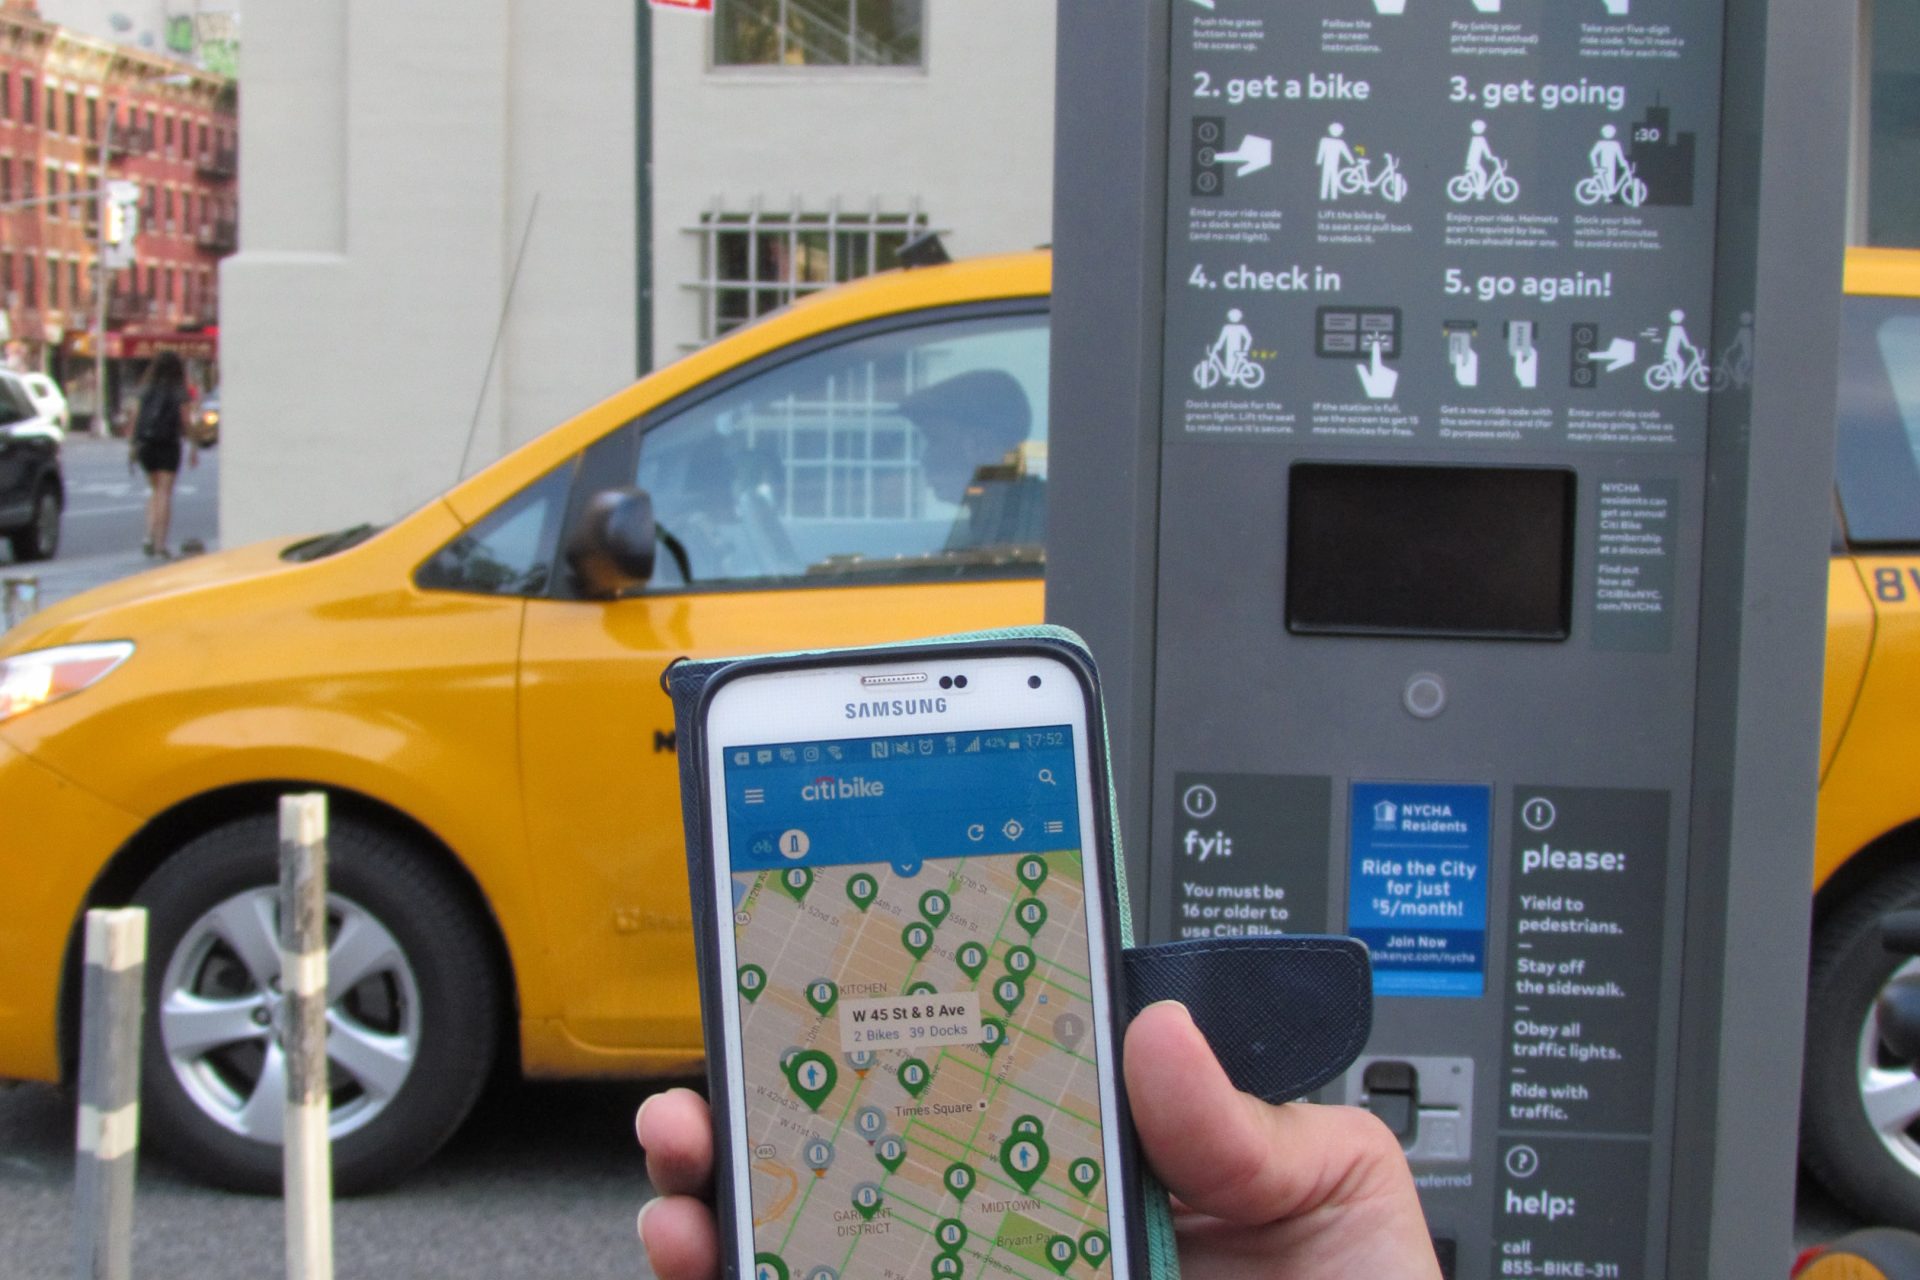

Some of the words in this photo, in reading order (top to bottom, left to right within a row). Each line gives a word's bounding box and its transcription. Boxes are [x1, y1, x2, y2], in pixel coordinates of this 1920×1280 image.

[1193, 71, 1220, 98] 2.
[1227, 75, 1278, 104] get
[1285, 79, 1301, 99] a
[1308, 73, 1370, 99] bike
[1449, 76, 1476, 101] 3.
[1483, 80, 1535, 109] get
[1541, 78, 1625, 111] going
[1634, 127, 1660, 142] :30
[1188, 264, 1217, 290] 4.
[1223, 264, 1310, 292] check
[1315, 266, 1342, 292] in
[1444, 268, 1472, 294] 5.
[1477, 276, 1516, 302] go
[1522, 271, 1611, 303] again!
[1601, 483, 1640, 493] NYCHA
[1601, 497, 1647, 506] residents
[1601, 510, 1617, 519] get
[1600, 520, 1619, 530] Citi
[1621, 521, 1642, 531] Bike
[1599, 533, 1662, 544] membership
[1598, 564, 1621, 574] Find
[1622, 565, 1640, 574] out
[1597, 577, 1619, 587] how
[845, 697, 948, 720] SAMSUNG
[1026, 732, 1064, 747] 17:52
[801, 777, 836, 802] citi
[838, 776, 885, 800] bike
[1402, 804, 1452, 817] NYCHA
[1402, 820, 1468, 833] Residents
[1184, 829, 1232, 862] fyi:
[1522, 842, 1627, 874] please:
[1362, 860, 1402, 876] Ride
[1407, 861, 1435, 877] the
[1440, 861, 1477, 881] City
[1183, 882, 1214, 898] You
[1217, 884, 1260, 899] must
[1263, 884, 1285, 900] be
[1386, 881, 1412, 896] for
[1415, 881, 1451, 900] just
[1182, 903, 1200, 918] 16
[1202, 907, 1220, 918] or
[1223, 903, 1267, 920] older
[1269, 906, 1289, 921] to
[1372, 899, 1464, 918] $5/month!
[1520, 896, 1563, 912] Yield
[1564, 898, 1585, 913] to
[1182, 926, 1211, 938] use
[1213, 924, 1244, 938] Citi
[1518, 917, 1624, 935] pedestrians.
[1387, 936, 1416, 949] Join
[1418, 936, 1448, 949] Now
[1517, 957, 1556, 977] Stay
[1558, 959, 1586, 975] off
[840, 981, 888, 996] KITCHEN
[1516, 980, 1545, 995] the
[1547, 981, 1626, 998] sidewalk.
[853, 1010, 868, 1023] W
[871, 1007, 890, 1021] 45
[893, 1004, 909, 1020] St
[912, 1005, 922, 1018] &
[926, 1003, 935, 1017] 8
[939, 1003, 966, 1017] Ave
[855, 1030, 862, 1042] 2
[867, 1027, 901, 1041] Bikes
[909, 1025, 926, 1038] 39
[930, 1021, 969, 1038] Docks
[1514, 1020, 1559, 1039] Obey
[1561, 1023, 1581, 1038] all
[1513, 1042, 1567, 1057] traffic
[1569, 1044, 1623, 1062] lights.
[1510, 1082, 1549, 1099] Ride
[1551, 1084, 1589, 1101] with
[894, 1103, 932, 1119] Times
[933, 1100, 973, 1117] Square
[1510, 1104, 1569, 1121] traffic.
[1414, 1173, 1473, 1188] referred
[981, 1199, 1041, 1214] MIDTOWN
[1504, 1188, 1577, 1221] help:
[833, 1207, 893, 1222] GARNT
[837, 1222, 891, 1238] DISTRICT
[996, 1234, 1033, 1249] Bryant
[1502, 1240, 1531, 1255] call
